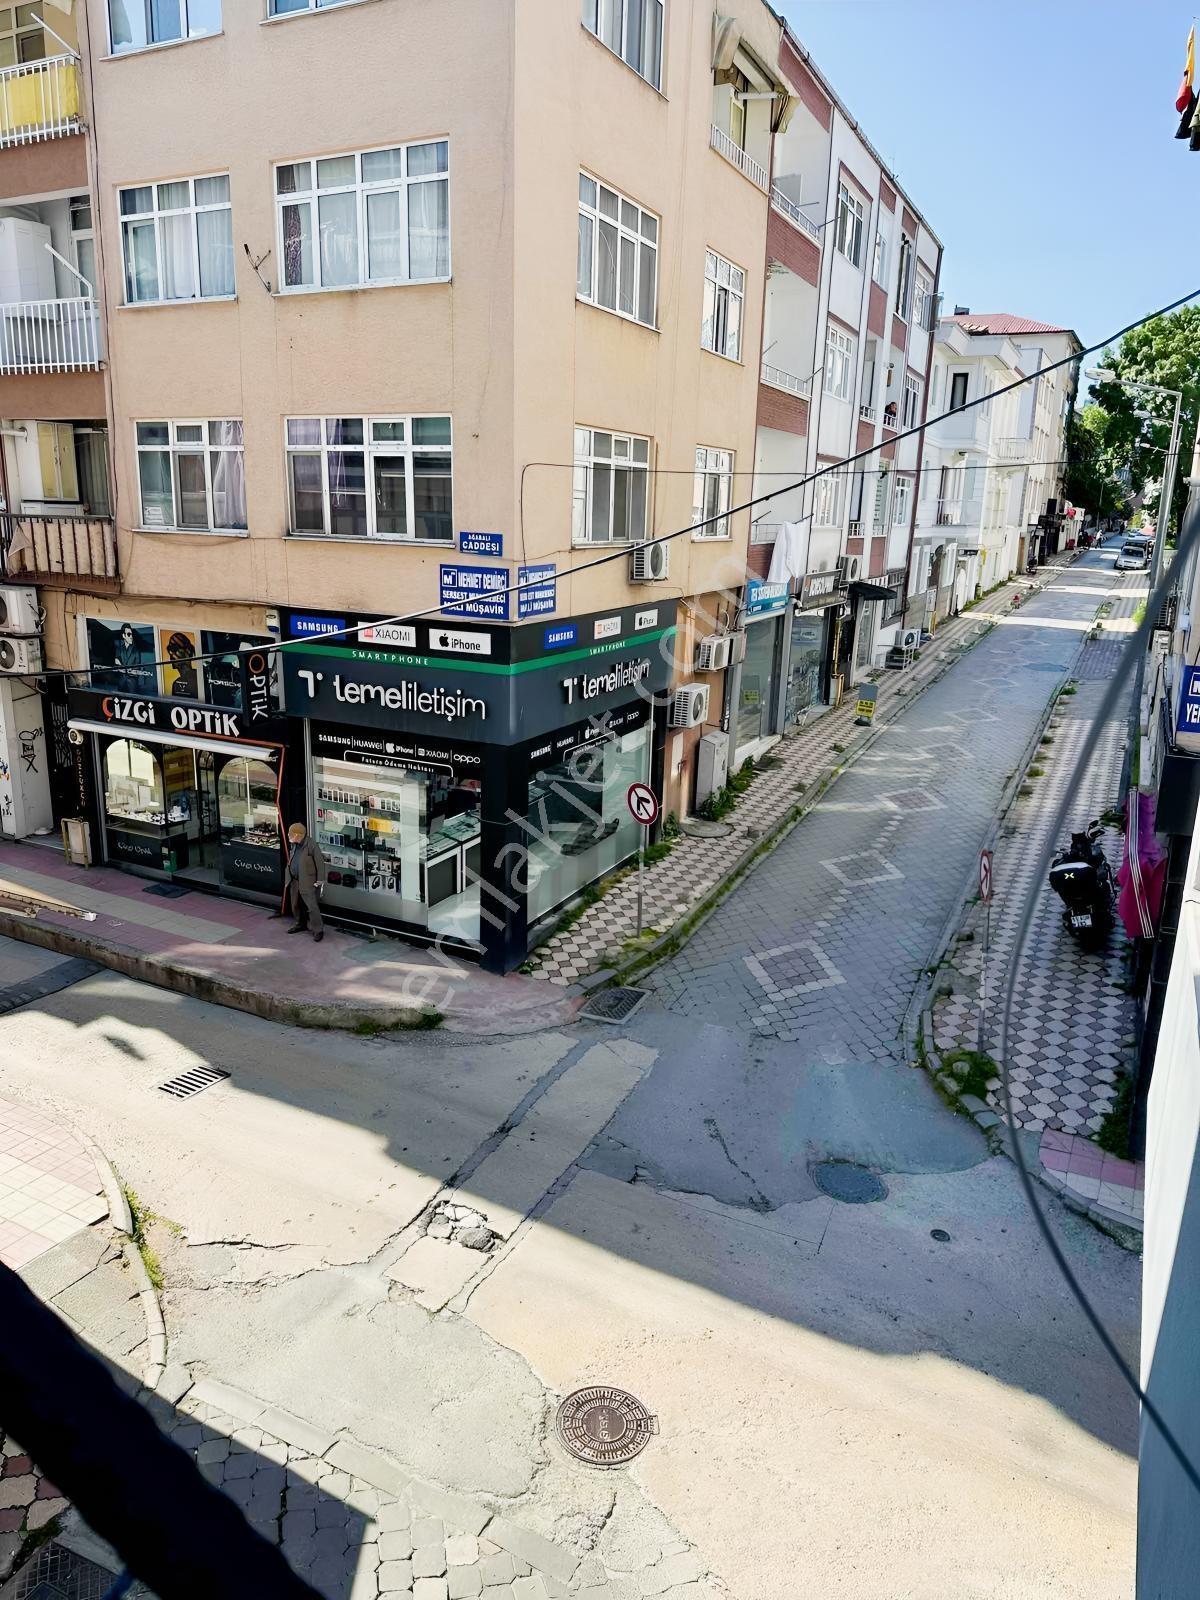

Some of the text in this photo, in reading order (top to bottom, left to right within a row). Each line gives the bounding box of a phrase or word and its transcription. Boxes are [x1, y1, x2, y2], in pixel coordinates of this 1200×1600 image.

[465, 602, 504, 615] MÜŞAVİR
[296, 621, 339, 633] SAMSUNG
[375, 628, 411, 642] XIAOMI
[451, 638, 481, 651] iPhone
[351, 650, 429, 666] SMARTPHONE
[102, 696, 240, 738] ÇİZGİ OPTİK
[318, 734, 351, 745] SAMSUNG
[353, 739, 383, 750] HUAWEI
